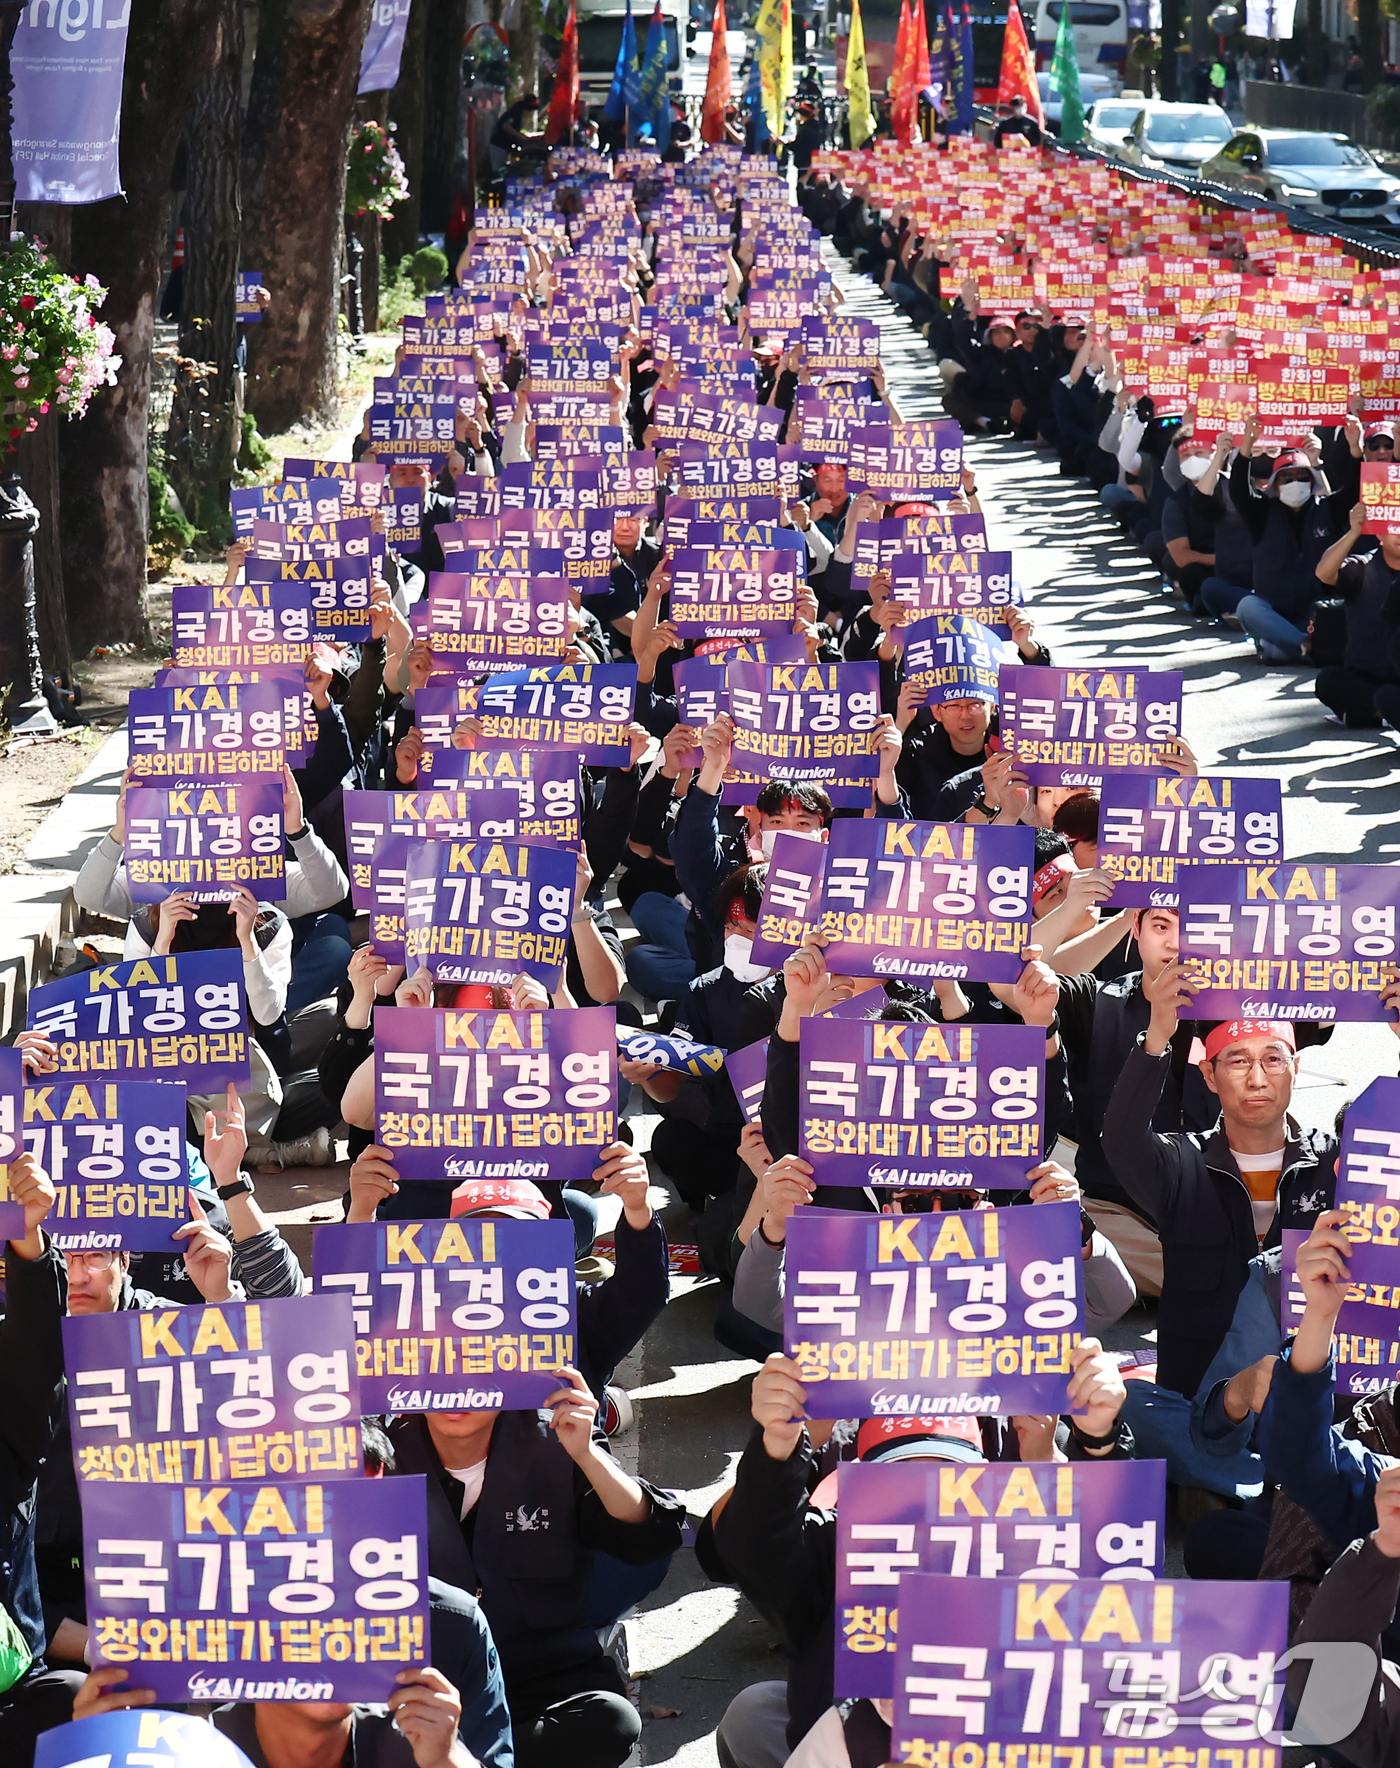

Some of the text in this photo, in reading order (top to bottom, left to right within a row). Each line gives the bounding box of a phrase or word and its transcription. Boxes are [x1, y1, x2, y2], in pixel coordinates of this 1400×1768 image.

[767, 291, 795, 301] KAI
[425, 318, 455, 328] KAI
[827, 325, 858, 336] KAI
[1338, 310, 1371, 321] 한화의
[405, 327, 473, 345] 국가경영
[808, 337, 879, 355] 국가경영
[1327, 334, 1366, 348] 한화의
[530, 359, 610, 379] 국가경영
[553, 347, 587, 359] KAI
[1208, 359, 1248, 374] 한화의
[1281, 368, 1325, 383] 한화의
[1258, 383, 1348, 402] 방산독과점
[395, 405, 431, 418] KAI
[692, 408, 779, 442] 국가경영
[1259, 402, 1306, 416] 청와대가
[371, 418, 454, 439] 국가경영
[562, 426, 598, 440] KAI
[892, 431, 935, 447] KAI
[708, 444, 749, 459] KAI
[866, 448, 961, 472] 국가경영
[531, 471, 573, 487] KAI
[683, 457, 776, 484] 국가경영
[867, 472, 960, 488] 청와대가 답하라!
[287, 524, 337, 542] KAI
[537, 510, 584, 529] KAI
[706, 551, 759, 571] KAI
[926, 555, 978, 574] KAI
[212, 587, 270, 608] KAI
[470, 577, 528, 600] KAI
[674, 571, 794, 602] 국가경영
[893, 574, 1010, 607] 국가경영
[176, 608, 308, 644] 국가경영
[316, 610, 369, 626] 답하라!
[431, 598, 565, 634] 국가경영
[671, 603, 795, 622] 청와대가 답하라!
[176, 647, 250, 668] 청와대가
[430, 632, 504, 654] 청와대가
[529, 665, 593, 682] KAI
[772, 666, 837, 692] KAI
[1066, 672, 1135, 699] KAI
[174, 686, 238, 711] KAI
[483, 684, 631, 721] 국가경영
[733, 689, 878, 732] 국가경영
[132, 710, 281, 751] 국가경영
[480, 715, 560, 742] 청와대가
[1019, 698, 1178, 740] 국가경영
[733, 726, 810, 758] 청와대가
[1017, 741, 1105, 765] 청와대가
[132, 750, 283, 777] 청와대가 답하라!
[468, 752, 530, 777] KAI
[169, 788, 236, 815] KAI
[394, 792, 466, 820] KAI
[1156, 777, 1232, 807] KAI
[129, 813, 281, 857] 국가경영
[883, 822, 975, 860] KAI
[1103, 807, 1279, 856] 국가경영
[129, 855, 283, 883] 청와대가 답하라!
[448, 844, 529, 877] KAI
[827, 857, 1028, 917] 국가경영
[1246, 867, 1336, 900] KAI
[407, 877, 570, 932] 국가경영
[406, 926, 566, 966] 청와대가 답하라!
[820, 910, 1029, 953] 청와대가 답하라!
[1185, 904, 1396, 957] 국가경영
[90, 957, 177, 993] KAI
[32, 982, 241, 1038] 국가경영
[444, 1012, 543, 1049] KAI
[873, 1024, 972, 1062] KAI
[152, 1032, 245, 1068] 답하라!
[380, 1050, 612, 1110] 국가경영
[806, 1060, 1038, 1121] 국가경영
[23, 1084, 118, 1123] KAI
[379, 1111, 614, 1148] 청와대가 답하라!
[804, 1118, 1039, 1158] 청와대가 답하라!
[86, 1184, 185, 1219] 답하라!
[386, 1223, 495, 1265] KAI
[878, 1212, 999, 1264] KAI
[322, 1267, 570, 1333] 국가경영
[793, 1257, 1077, 1336] 국가경영
[139, 1304, 263, 1359] KAI
[462, 1333, 574, 1372] 답하라!
[791, 1337, 952, 1382] 청와대가
[74, 1350, 351, 1439] 국가경영
[79, 1427, 358, 1482] 청와대가 답하라!
[938, 1467, 1074, 1518] KAI
[183, 1484, 324, 1535] KAI
[845, 1520, 1156, 1586] 국가경영
[94, 1535, 420, 1614] 국가경영
[1015, 1584, 1174, 1643] KAI
[95, 1615, 424, 1663] 청와대가 답하라!
[904, 1643, 1276, 1742] 국가경영
